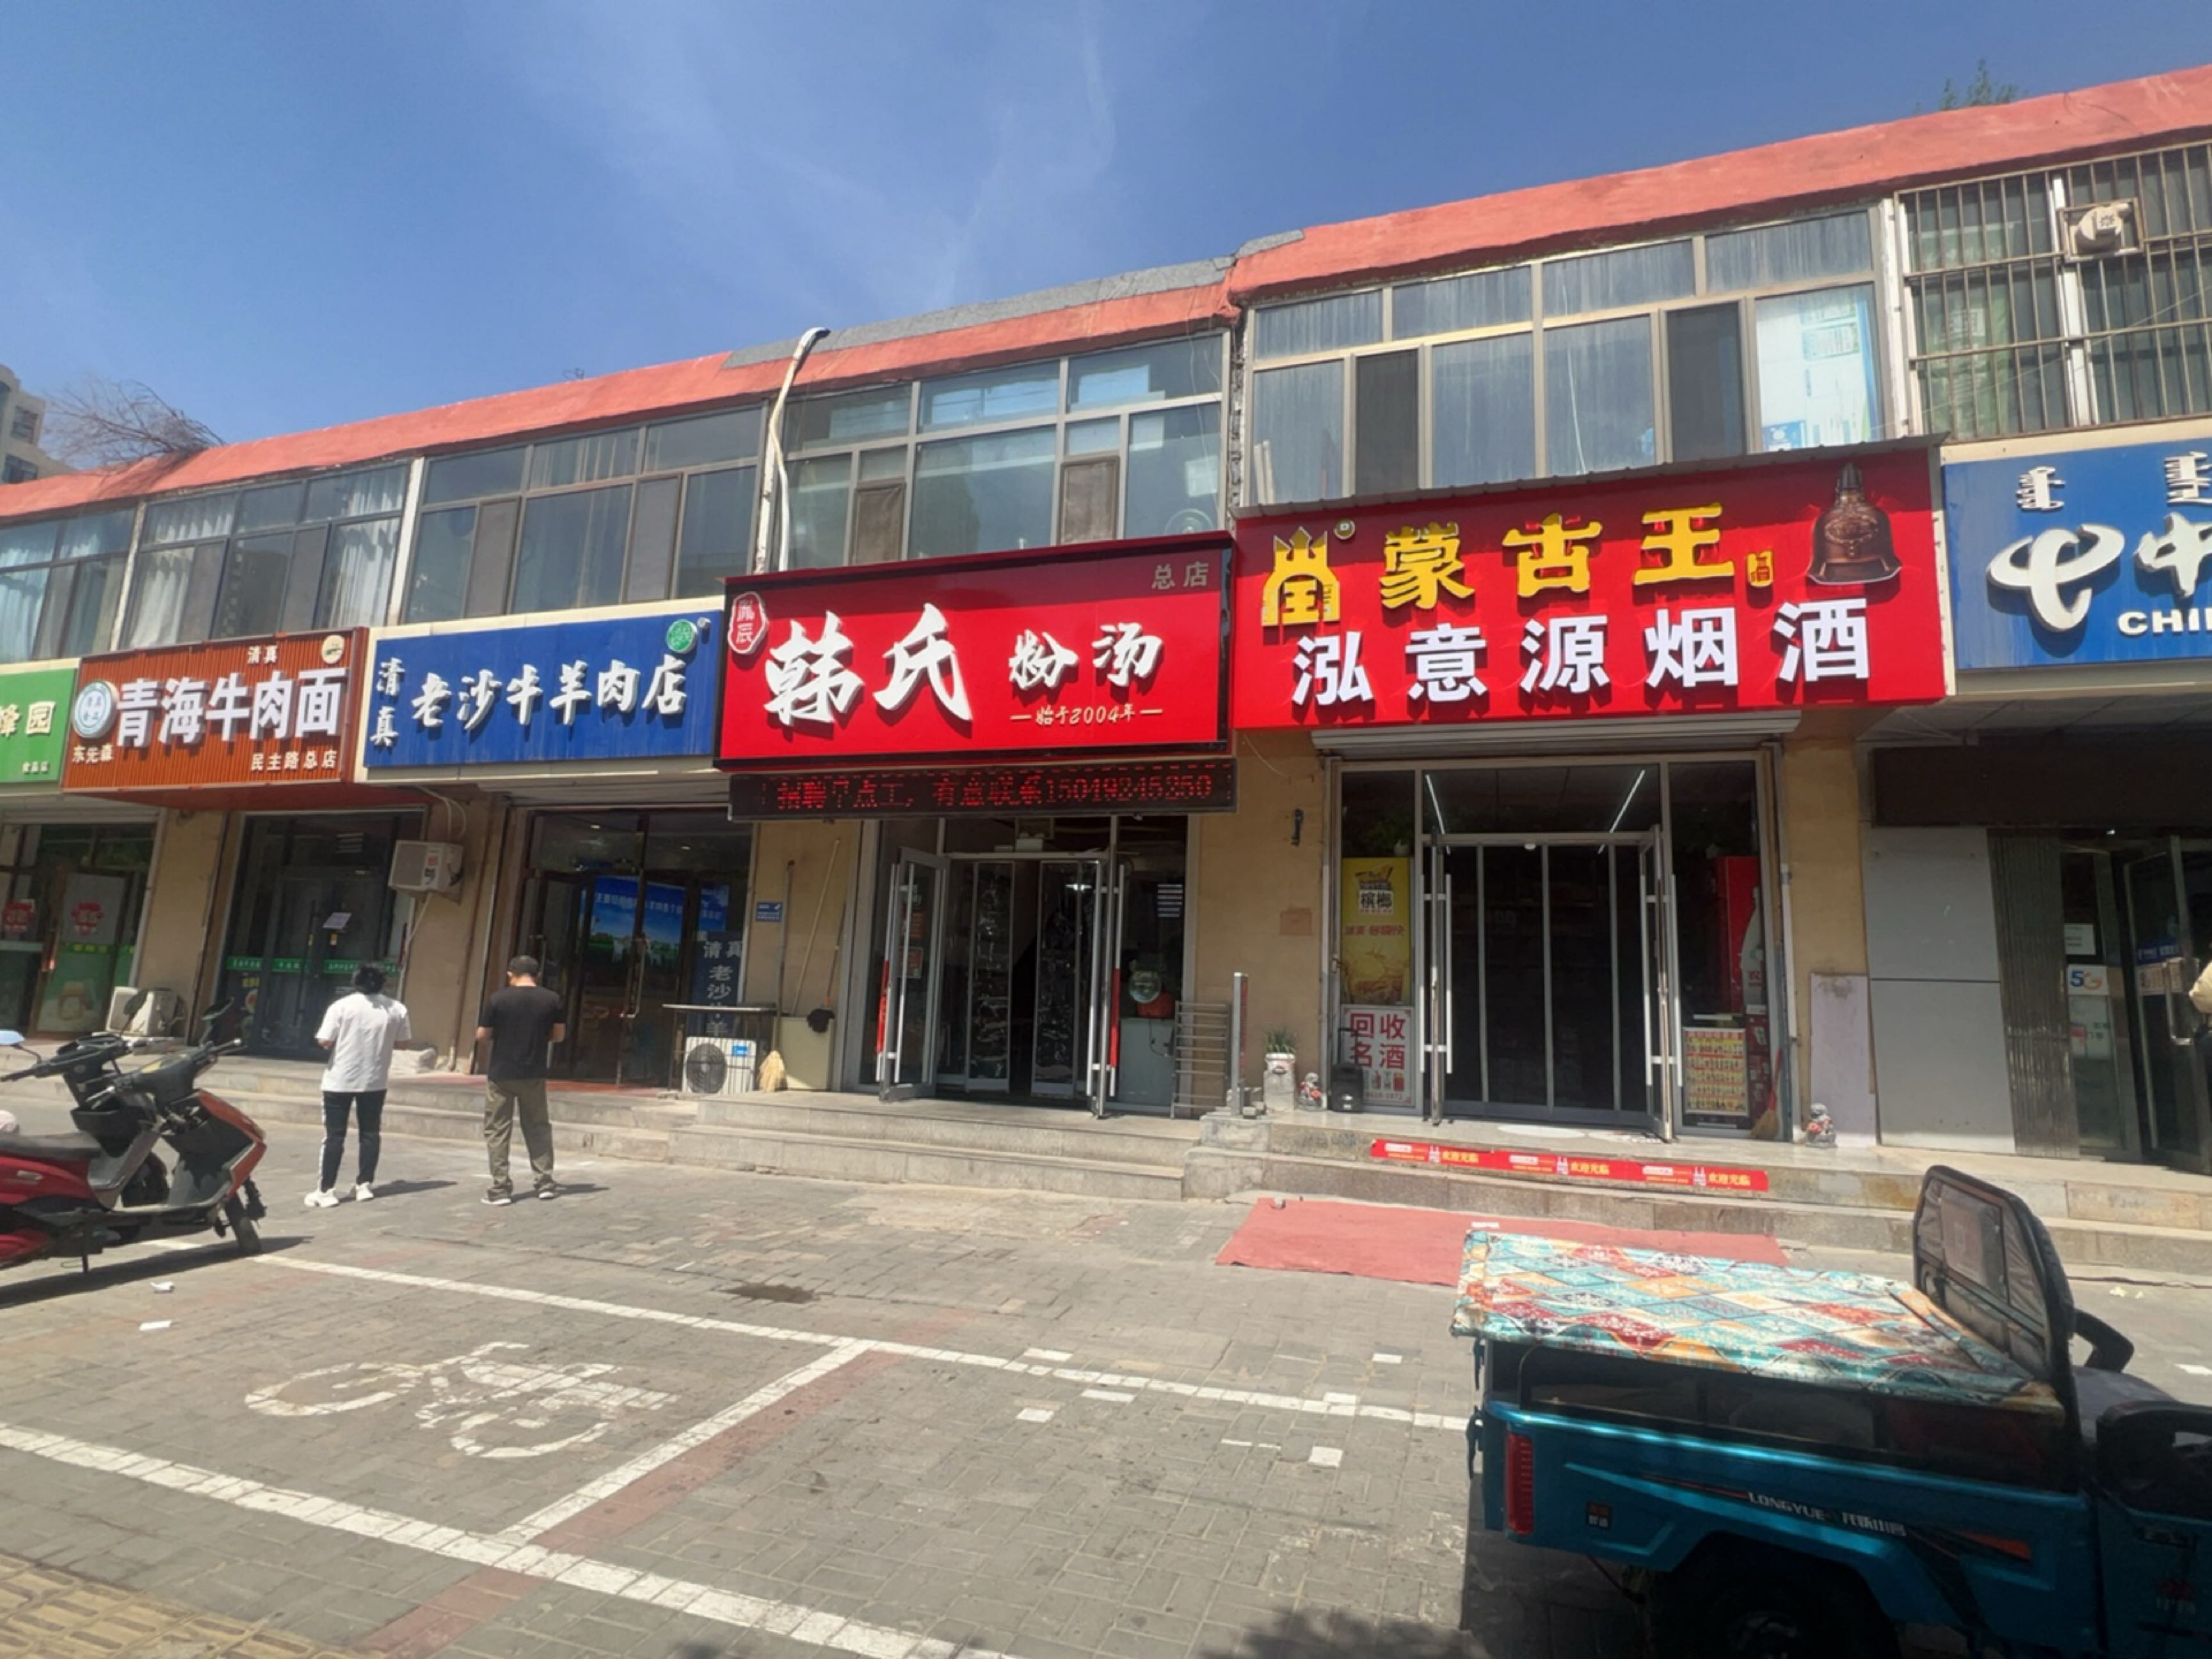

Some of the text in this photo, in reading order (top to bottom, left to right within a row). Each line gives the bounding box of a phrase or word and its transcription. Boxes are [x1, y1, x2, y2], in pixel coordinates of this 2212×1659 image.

[1380, 502, 1735, 611] 蒙古王
[1153, 561, 1209, 589] 总店
[2118, 608, 2212, 636] CHI
[247, 645, 278, 664] 清真
[1292, 597, 1870, 705] 泓意源烟酒
[370, 657, 405, 747] 清真
[412, 653, 687, 730] 老沙牛羊肉店
[115, 668, 348, 748] 青海牛肉面
[251, 749, 338, 771] 民主路总店
[2069, 970, 2103, 991] 5G
[1350, 1013, 1407, 1040] 回收
[1350, 1041, 1406, 1070] 名酒
